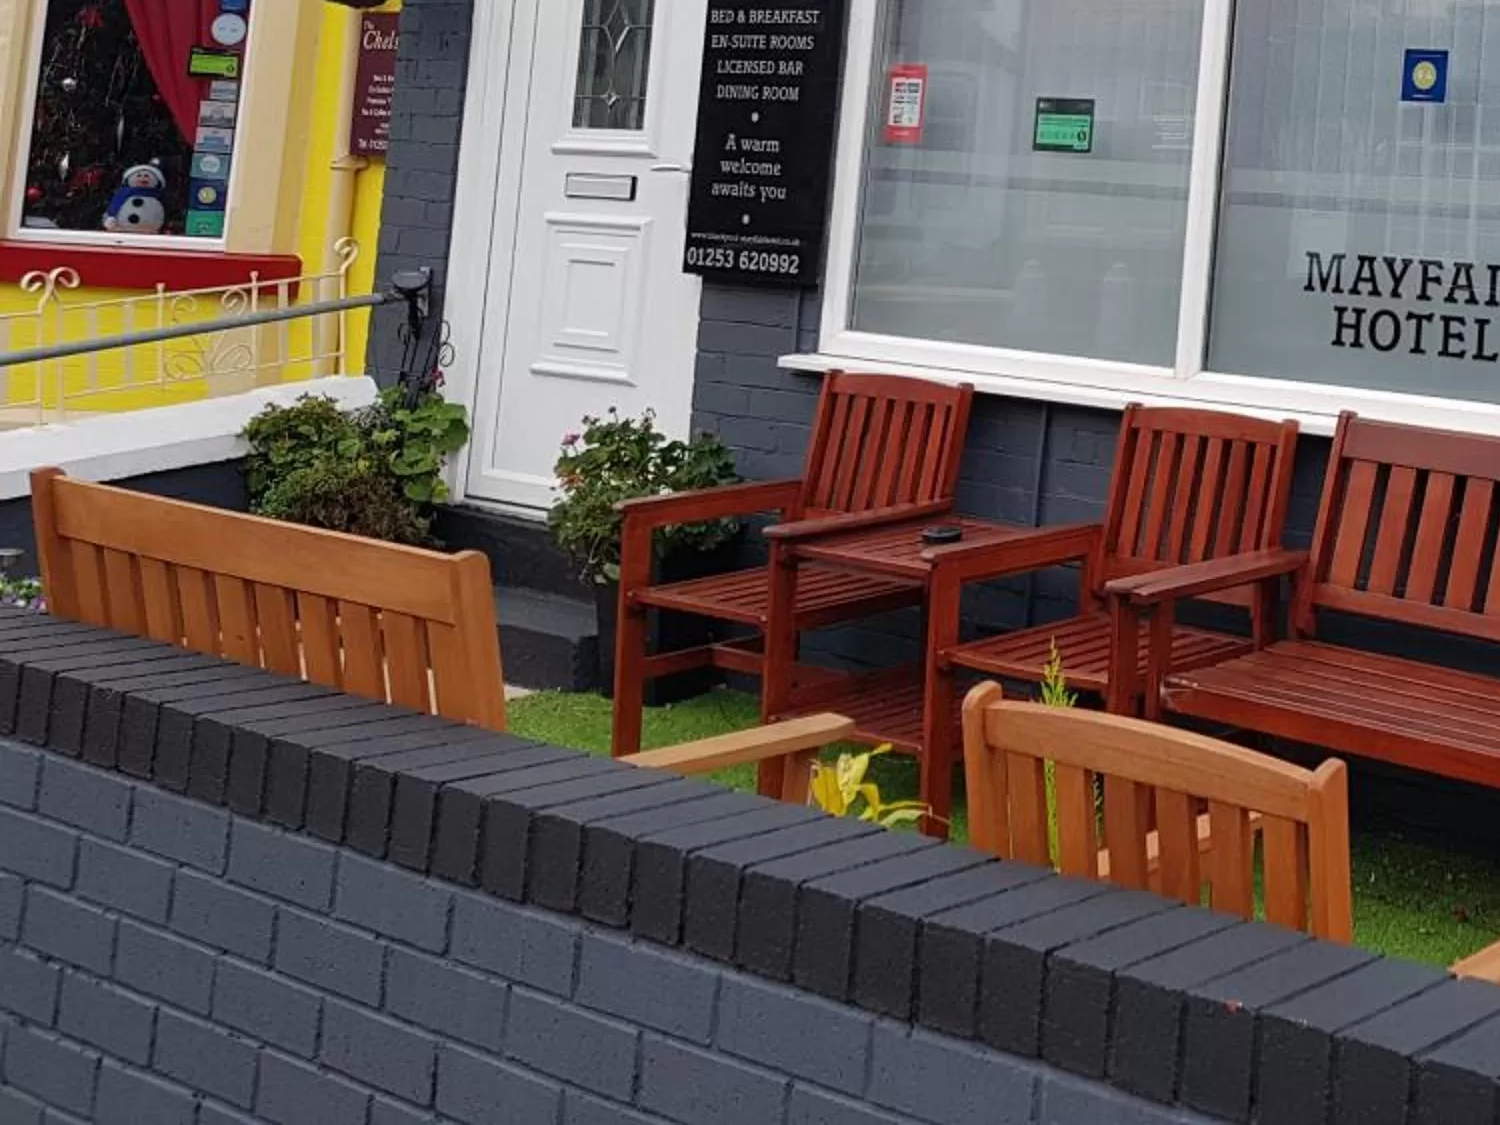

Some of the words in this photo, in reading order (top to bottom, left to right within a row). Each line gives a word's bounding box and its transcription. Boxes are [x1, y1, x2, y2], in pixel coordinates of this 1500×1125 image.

[710, 9, 735, 24] BED
[737, 10, 746, 24] &
[748, 10, 821, 24] BREAKFAST
[710, 33, 767, 49] EN-SUITE
[769, 35, 816, 50] ROOMS
[716, 58, 776, 75] LICENSED
[777, 60, 804, 76] BAR
[716, 83, 759, 100] DINING
[761, 85, 800, 102] ROOM
[724, 133, 737, 151] A
[740, 137, 780, 153] warm
[719, 157, 782, 177] welcome
[711, 180, 756, 199] awaits
[758, 184, 787, 203] you
[687, 246, 735, 268] 01253
[739, 250, 800, 275] 620992
[1331, 305, 1500, 363] HOTEL
